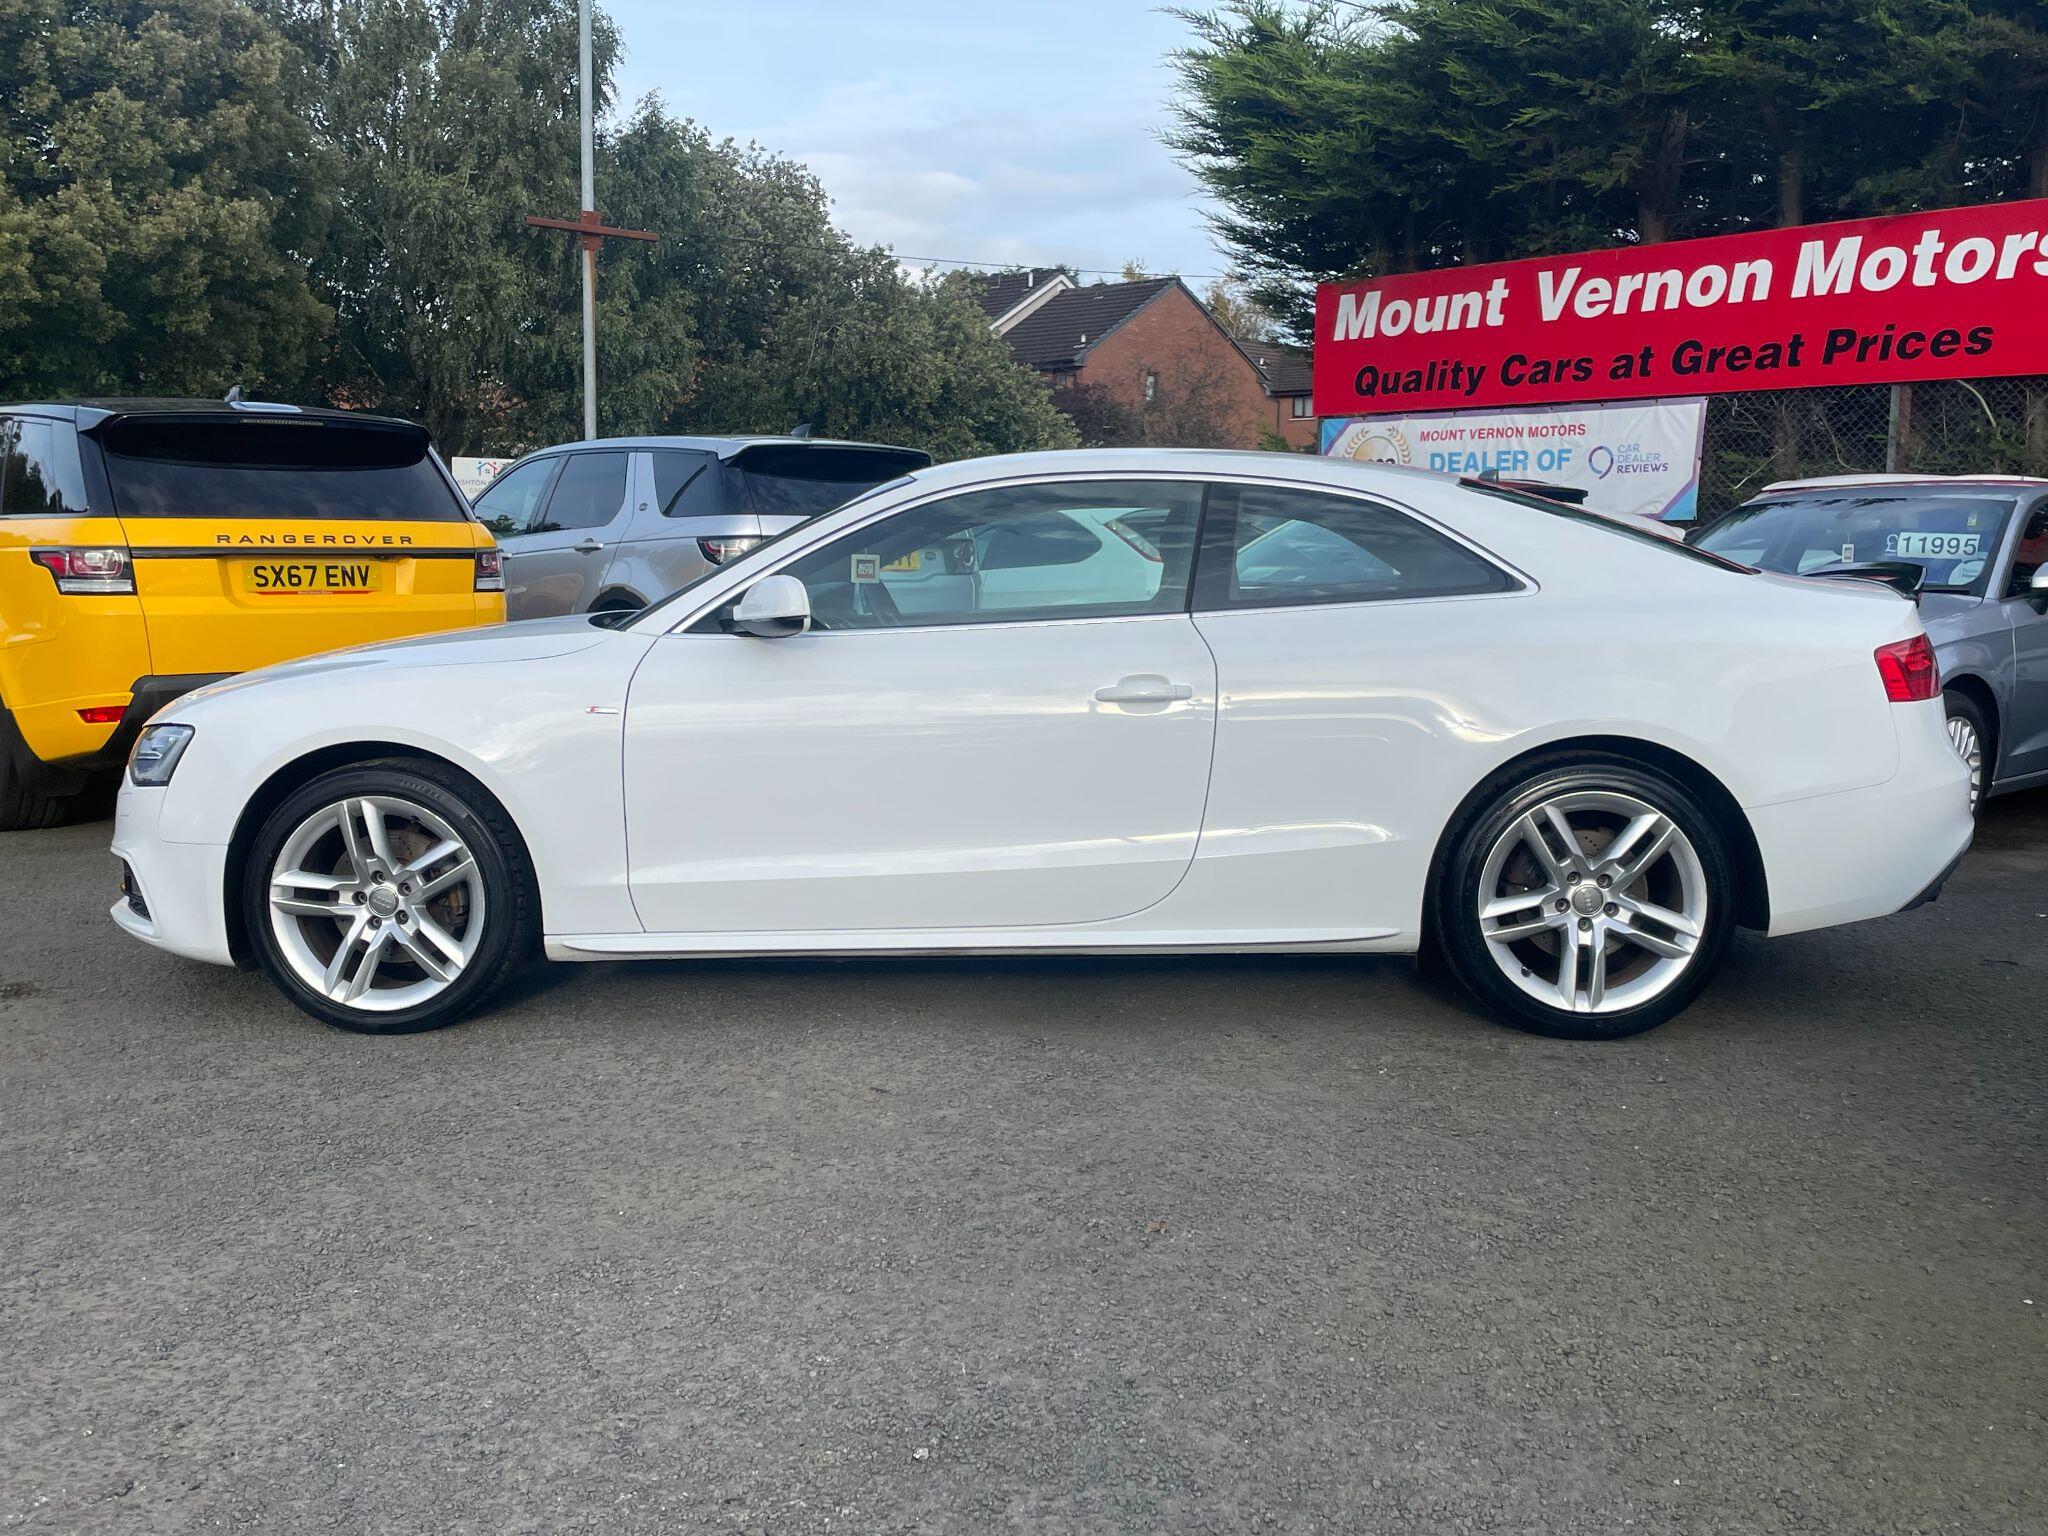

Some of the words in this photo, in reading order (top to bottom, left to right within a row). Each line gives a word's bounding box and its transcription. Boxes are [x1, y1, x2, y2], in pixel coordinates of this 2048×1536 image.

[1333, 278, 1509, 342] Mount
[1538, 258, 1774, 323] Vernon
[1354, 358, 1488, 398] Quality
[1500, 353, 1594, 386] Cars
[1609, 344, 1655, 381] at
[1671, 333, 1806, 376] Great
[1821, 323, 1995, 366] Prices
[1420, 429, 1466, 442] MOUNT
[1470, 426, 1525, 441] VERNON
[1527, 423, 1587, 439] MOTORS
[1617, 443, 1641, 453] CAR
[1617, 452, 1661, 464] DEALER
[1430, 450, 1529, 473] DEALER
[1537, 448, 1573, 471] OF
[1617, 462, 1669, 474] REVIEWS
[253, 565, 318, 588] SX67
[325, 564, 370, 588] ENV
